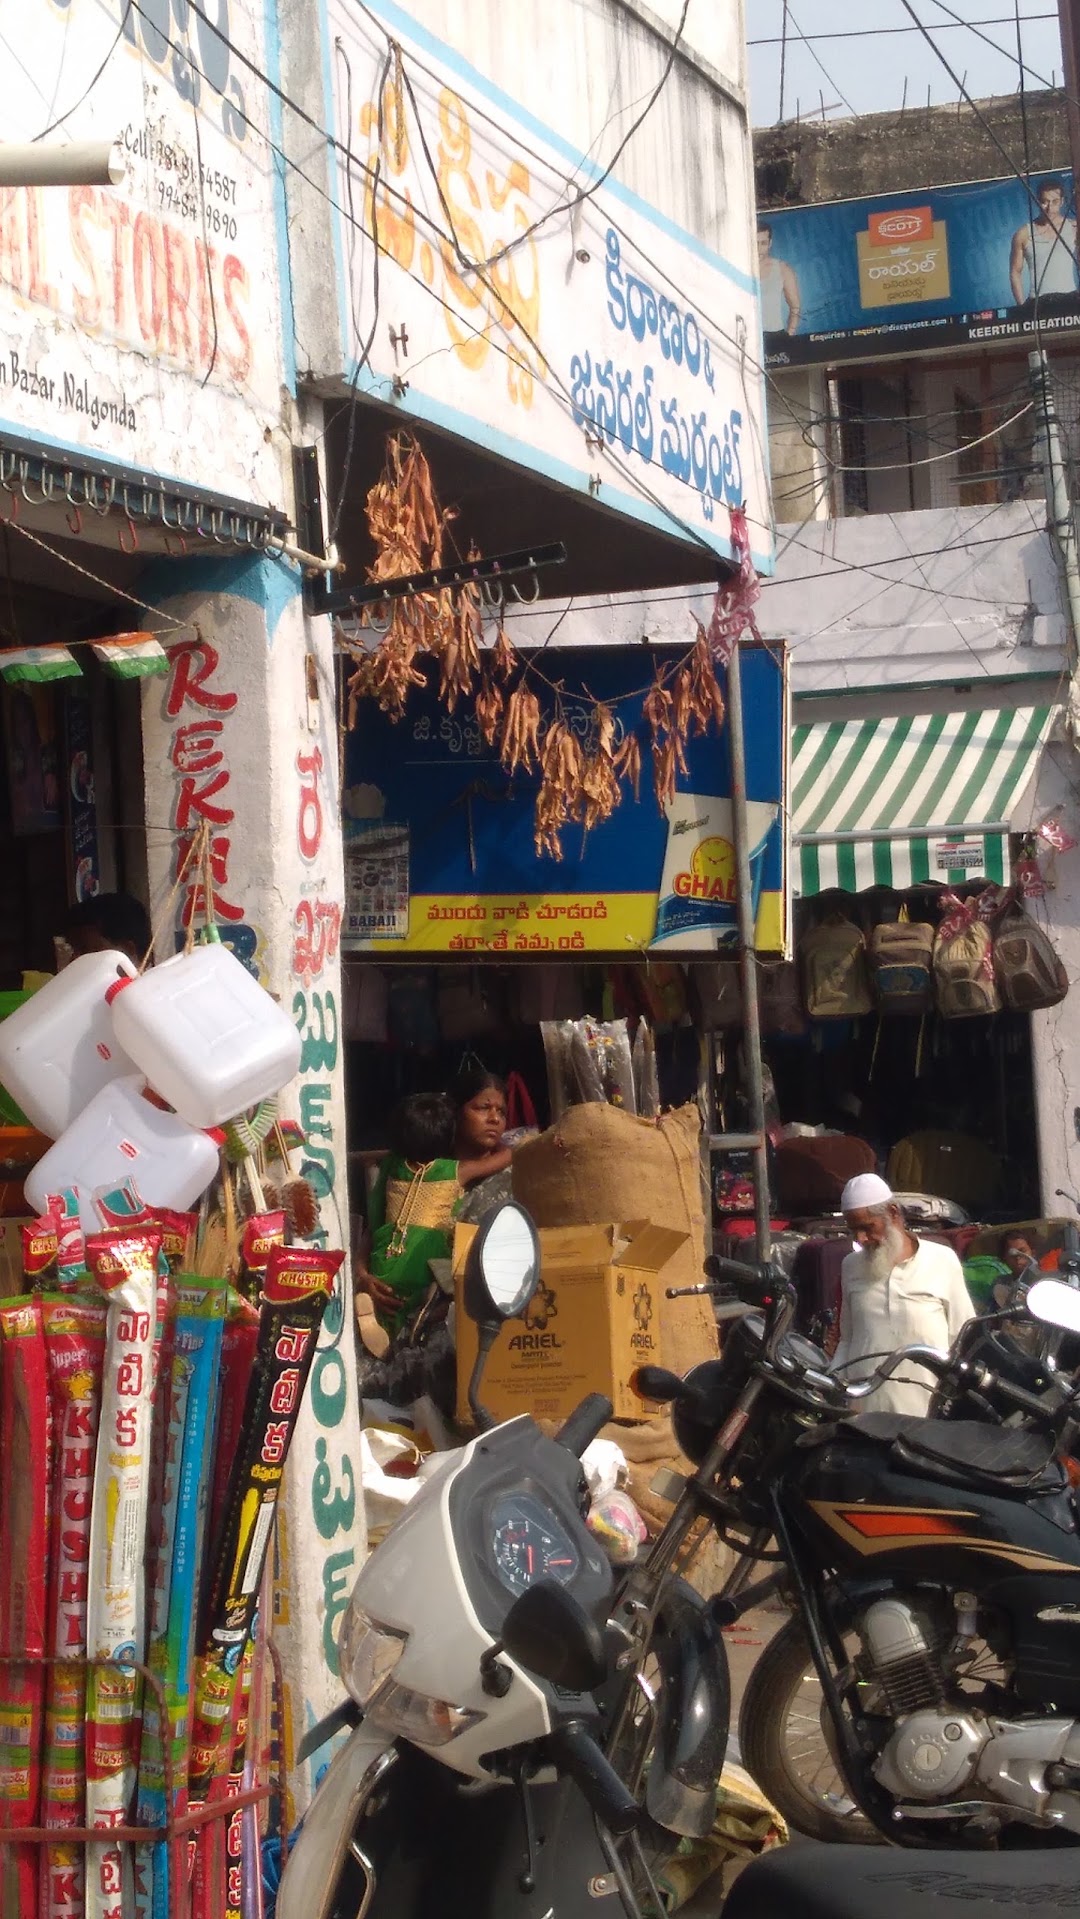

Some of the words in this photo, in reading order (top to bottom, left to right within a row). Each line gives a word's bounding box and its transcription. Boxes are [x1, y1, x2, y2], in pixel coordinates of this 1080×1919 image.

[878, 220, 922, 234] SCOTT
[869, 252, 938, 279] రాయల్
[968, 323, 1019, 339] KEERTHI
[64, 371, 136, 432] Nalgonda
[165, 640, 244, 927] REKHA
[427, 904, 487, 920] ముందు
[493, 901, 530, 920] వాడి
[536, 901, 607, 920] చూడండి
[349, 915, 396, 927] BABAJI
[508, 1333, 562, 1350] ARIEL
[630, 1334, 655, 1350] ARIEL
